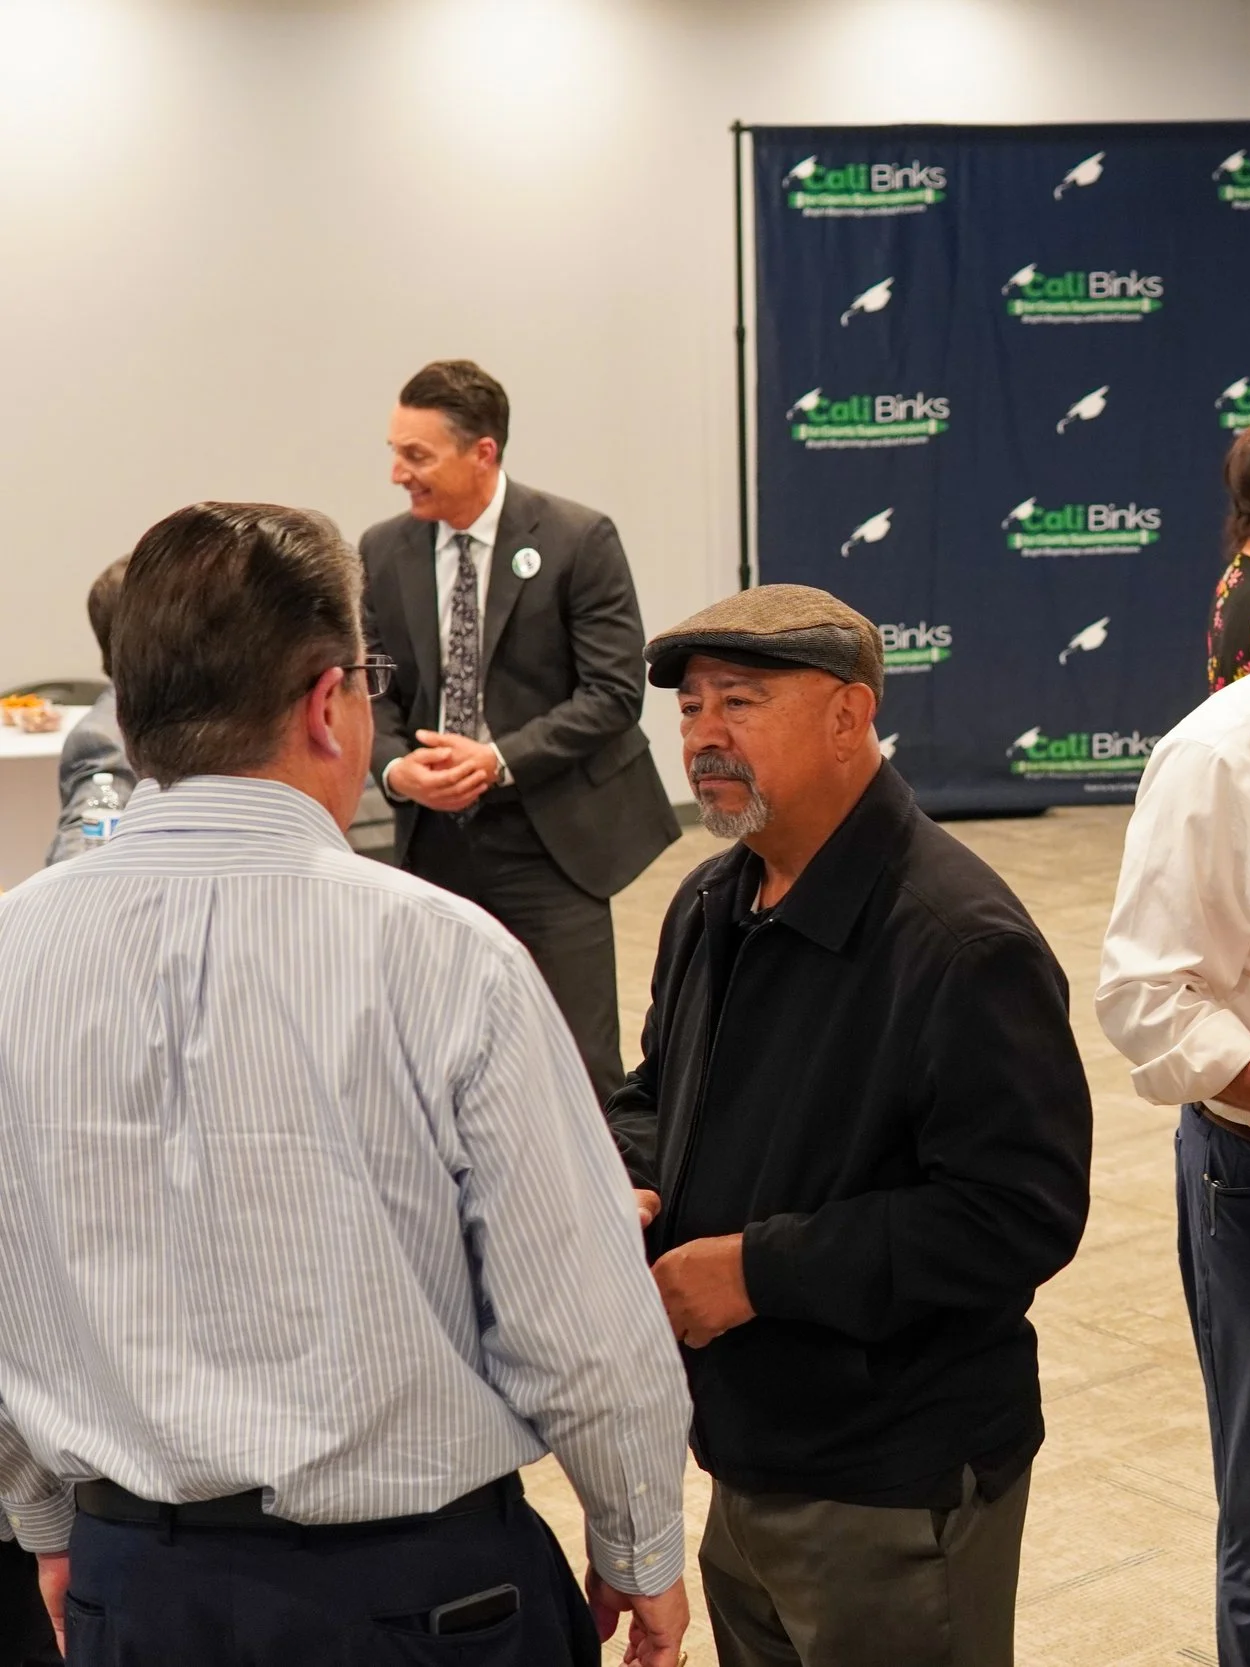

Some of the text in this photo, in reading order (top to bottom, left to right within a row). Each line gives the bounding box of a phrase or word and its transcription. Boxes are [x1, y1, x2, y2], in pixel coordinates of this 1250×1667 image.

[803, 159, 947, 192] Cali Binks
[1022, 269, 1164, 299] Cali Binks
[807, 391, 950, 423] Cali Binks
[1022, 502, 1161, 531] Cali Binks
[879, 620, 953, 651] Binks
[1026, 732, 1090, 759] Cali
